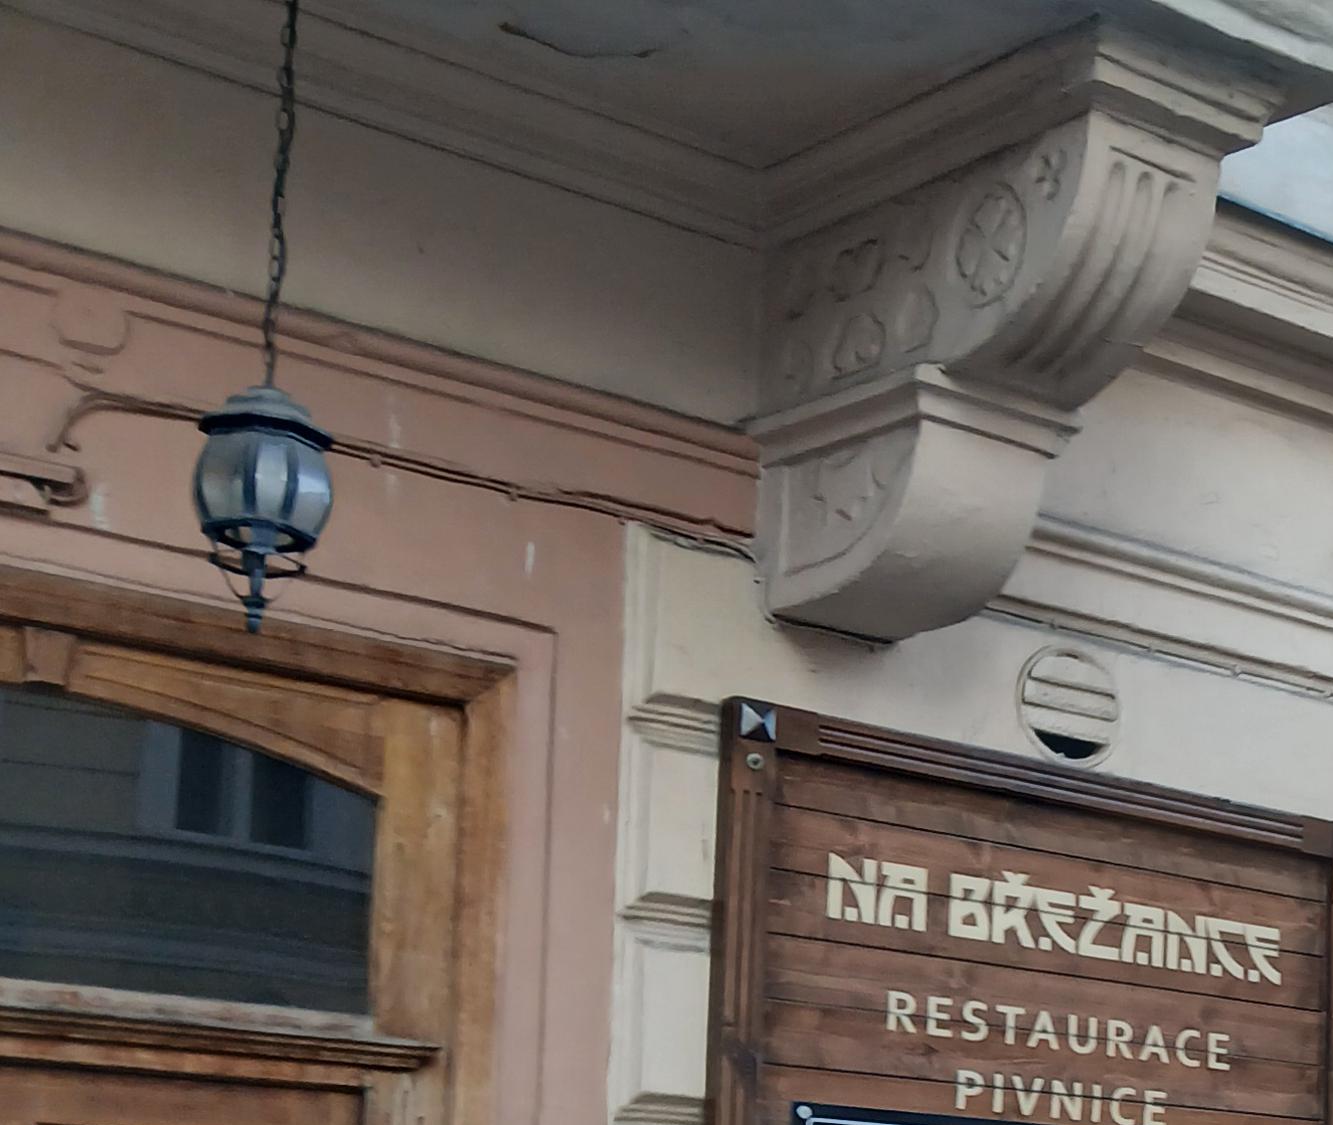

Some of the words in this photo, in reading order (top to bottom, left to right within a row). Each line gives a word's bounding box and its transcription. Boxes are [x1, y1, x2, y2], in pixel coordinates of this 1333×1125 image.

[826, 852, 928, 932] NA
[947, 871, 1282, 986] BŘEŽANCE
[886, 990, 1231, 1071] RESTAURACE
